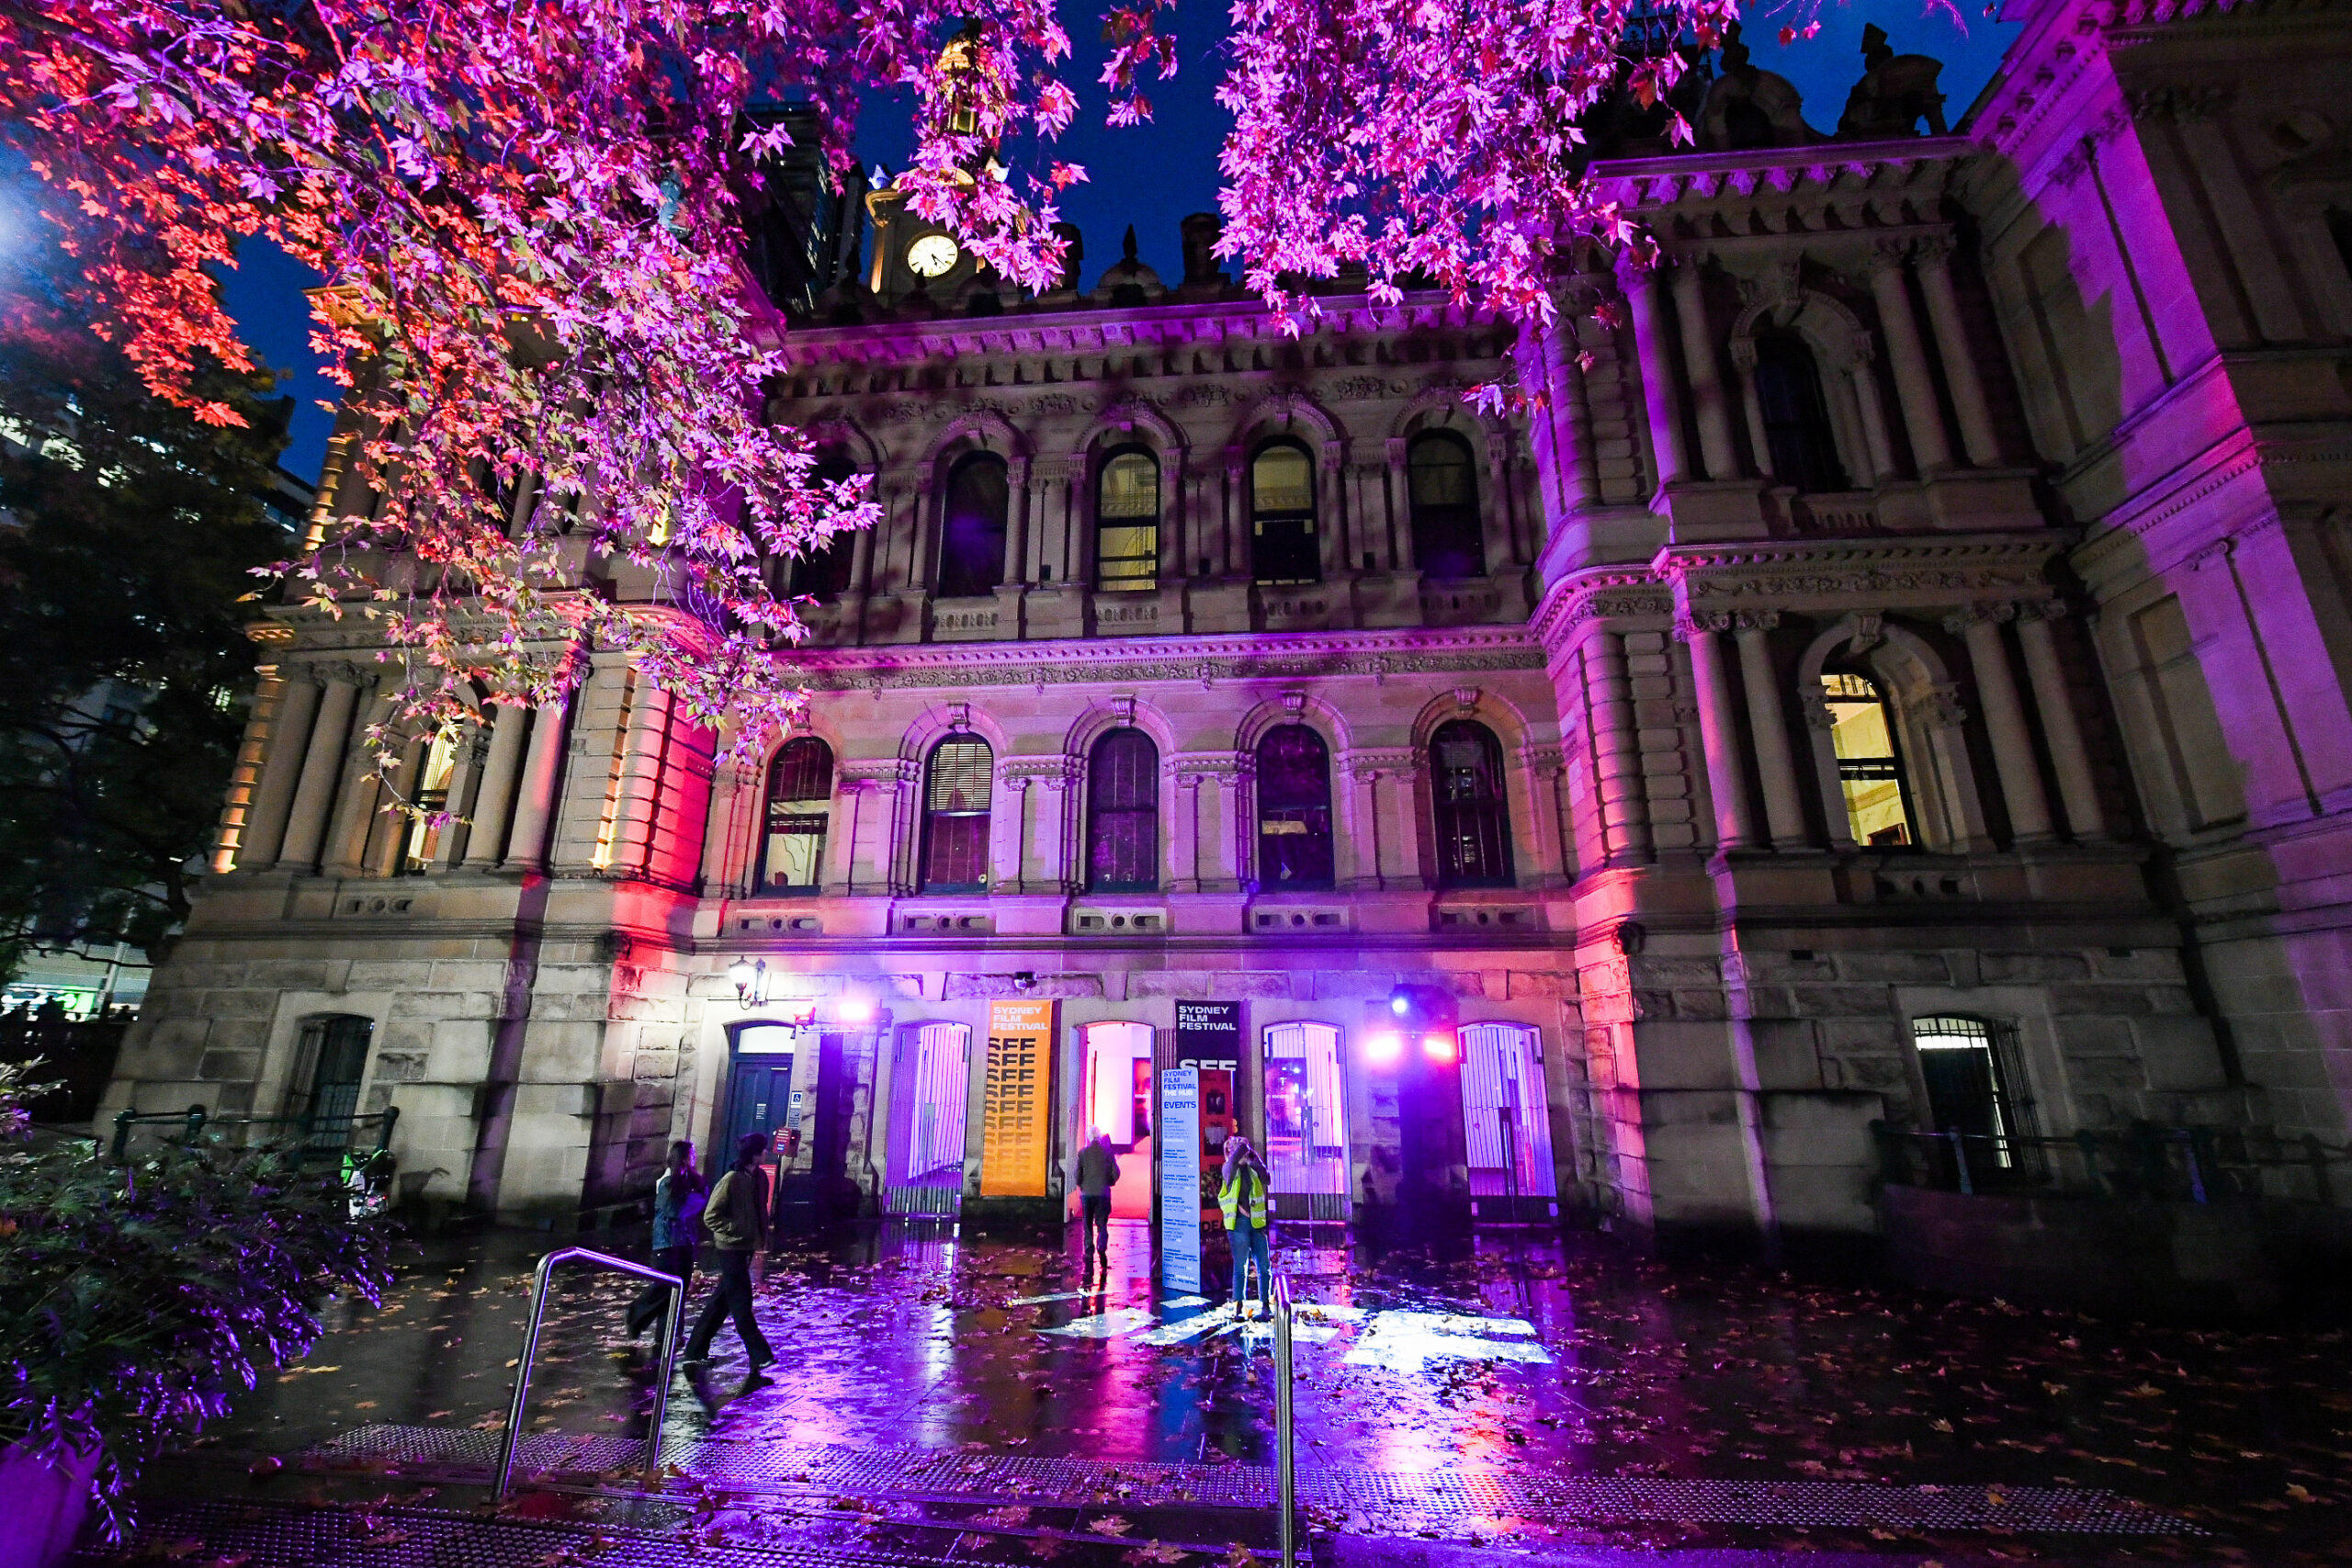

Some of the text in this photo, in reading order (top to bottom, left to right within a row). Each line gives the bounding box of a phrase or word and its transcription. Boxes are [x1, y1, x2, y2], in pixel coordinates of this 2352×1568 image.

[993, 1006, 1043, 1014] SYDNEY
[1179, 1006, 1229, 1014] SYDNEY
[993, 1014, 1022, 1022] FILM
